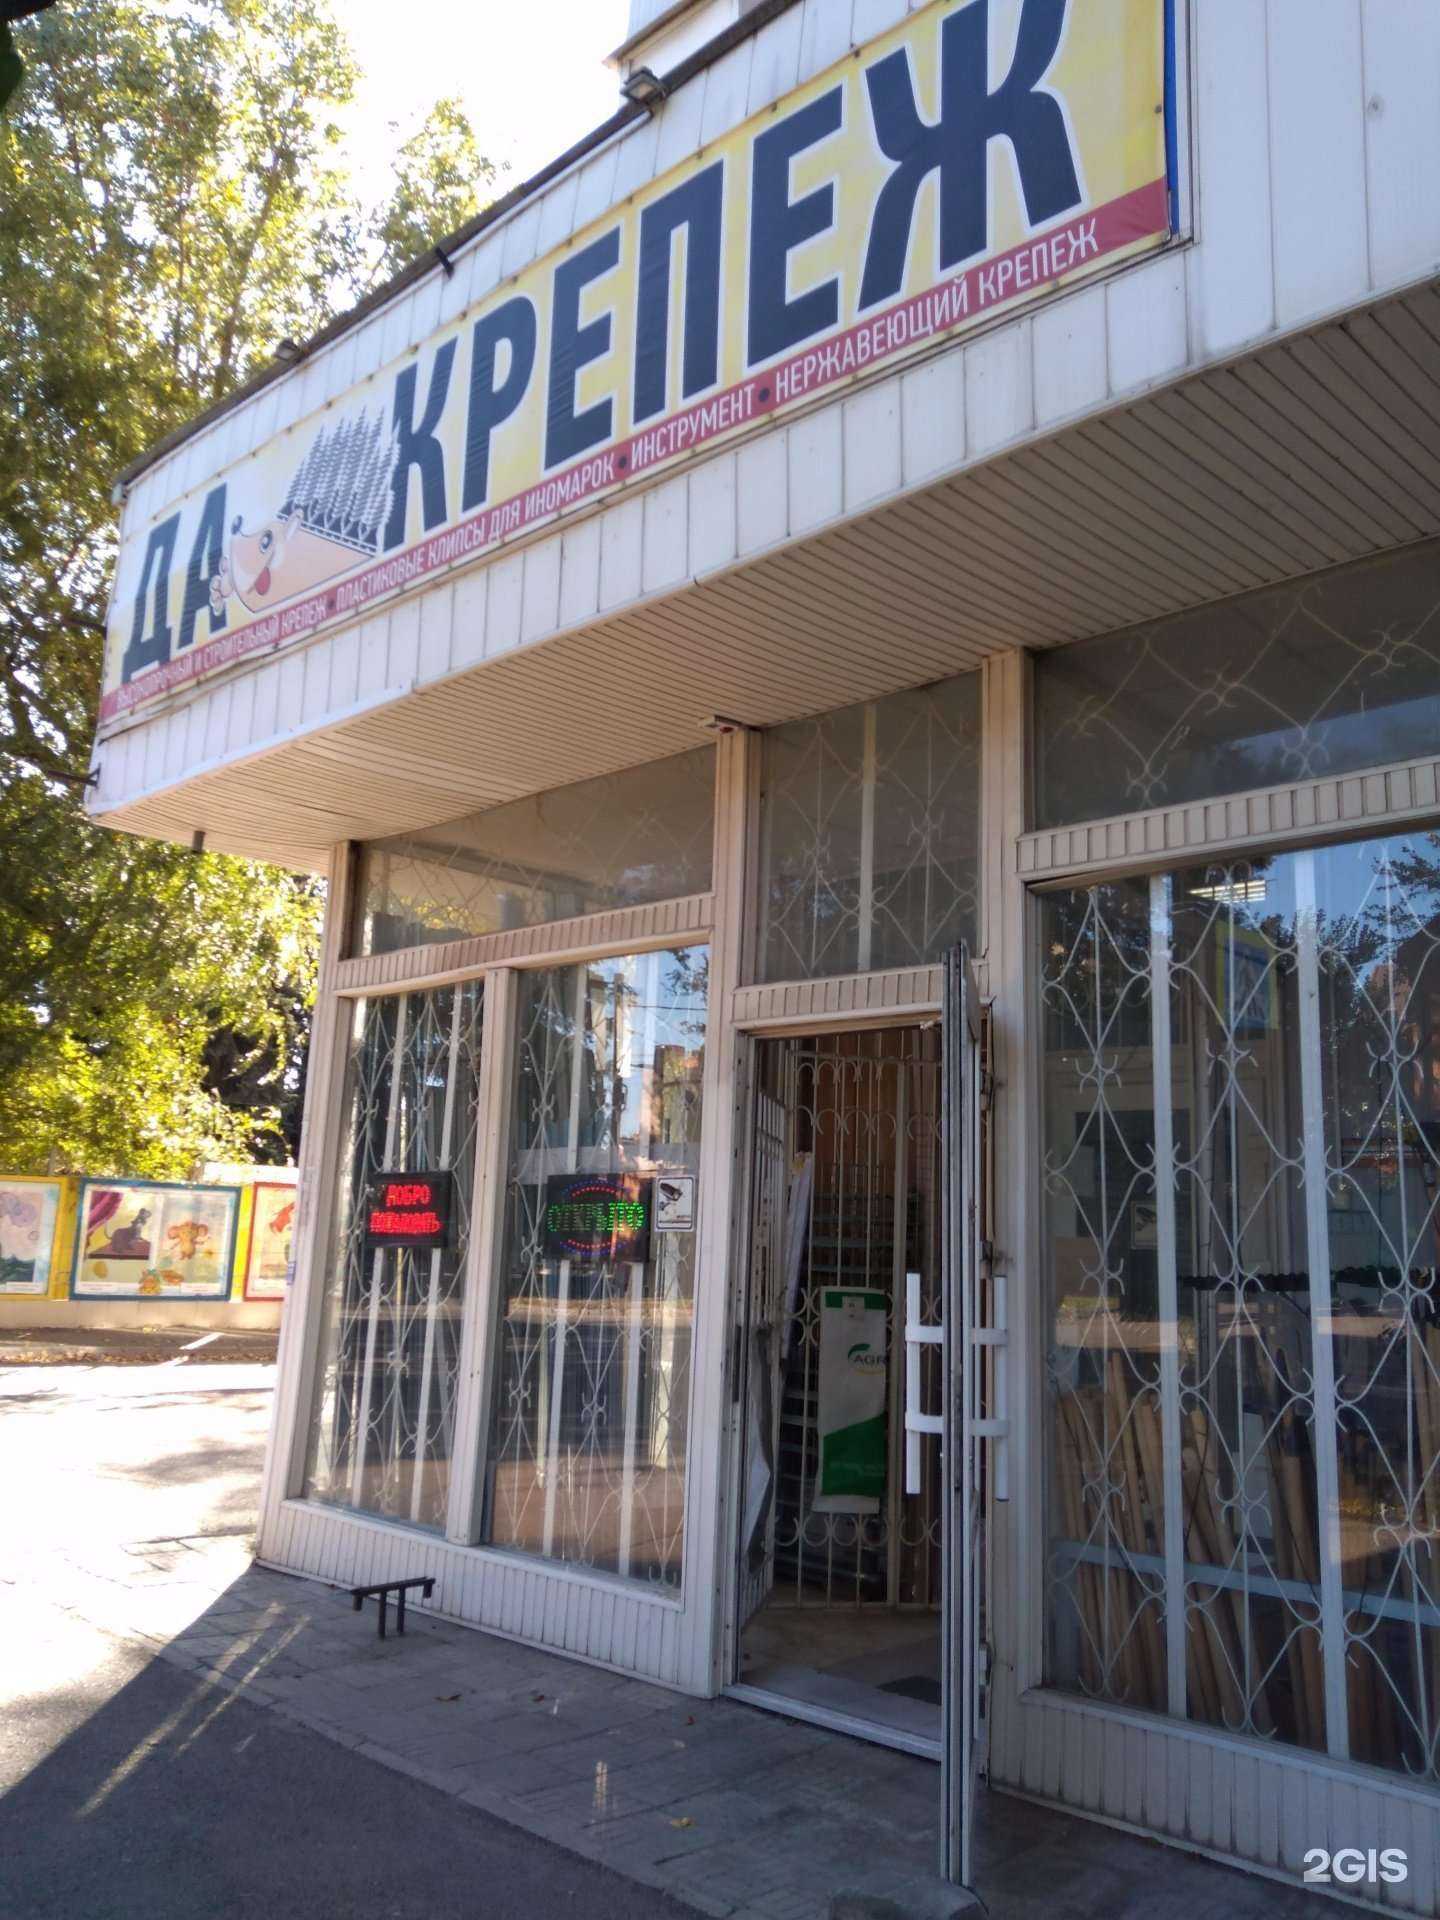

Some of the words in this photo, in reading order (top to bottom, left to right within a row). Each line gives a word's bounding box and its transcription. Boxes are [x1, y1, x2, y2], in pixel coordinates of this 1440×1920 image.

[122, 482, 227, 684] ДА
[382, 0, 1083, 552] КРЕПЕЖ
[281, 596, 327, 635] КРЕПЕЖ
[335, 547, 424, 612] ПЛАСТИКОВЫЕ
[427, 514, 486, 565] КЛИПСЫ
[487, 503, 520, 544] ДЛЯ
[524, 456, 614, 520] ИНОМАРОК
[631, 383, 755, 470] ИНСТРУМЕНТ
[775, 277, 968, 402] НЕРЖАВЕЮЩИЙ
[978, 218, 1099, 305] КРЕПЕЖ
[386, 1184, 432, 1207] ДОБРО
[547, 1202, 644, 1232] ОТКРЫТО
